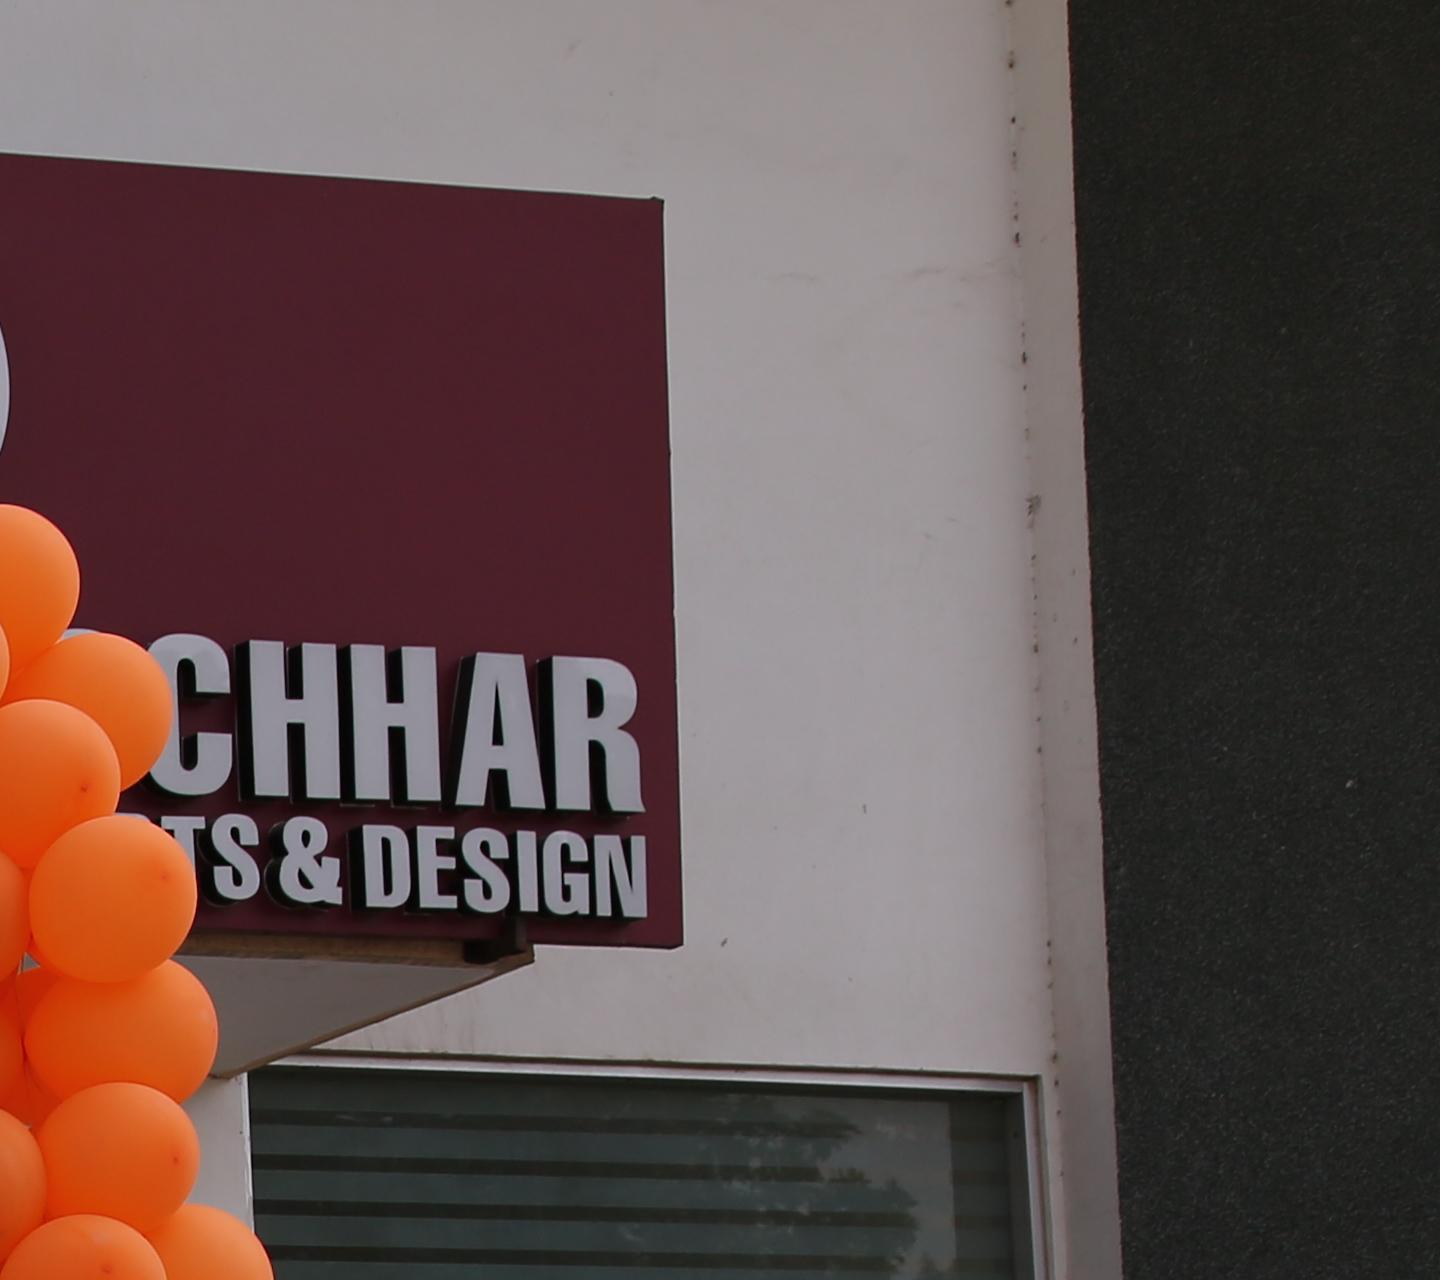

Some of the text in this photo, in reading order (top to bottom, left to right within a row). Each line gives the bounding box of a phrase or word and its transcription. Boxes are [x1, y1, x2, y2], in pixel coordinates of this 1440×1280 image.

[58, 628, 646, 814] CHHAR
[126, 812, 648, 919] TS & DESIGN
